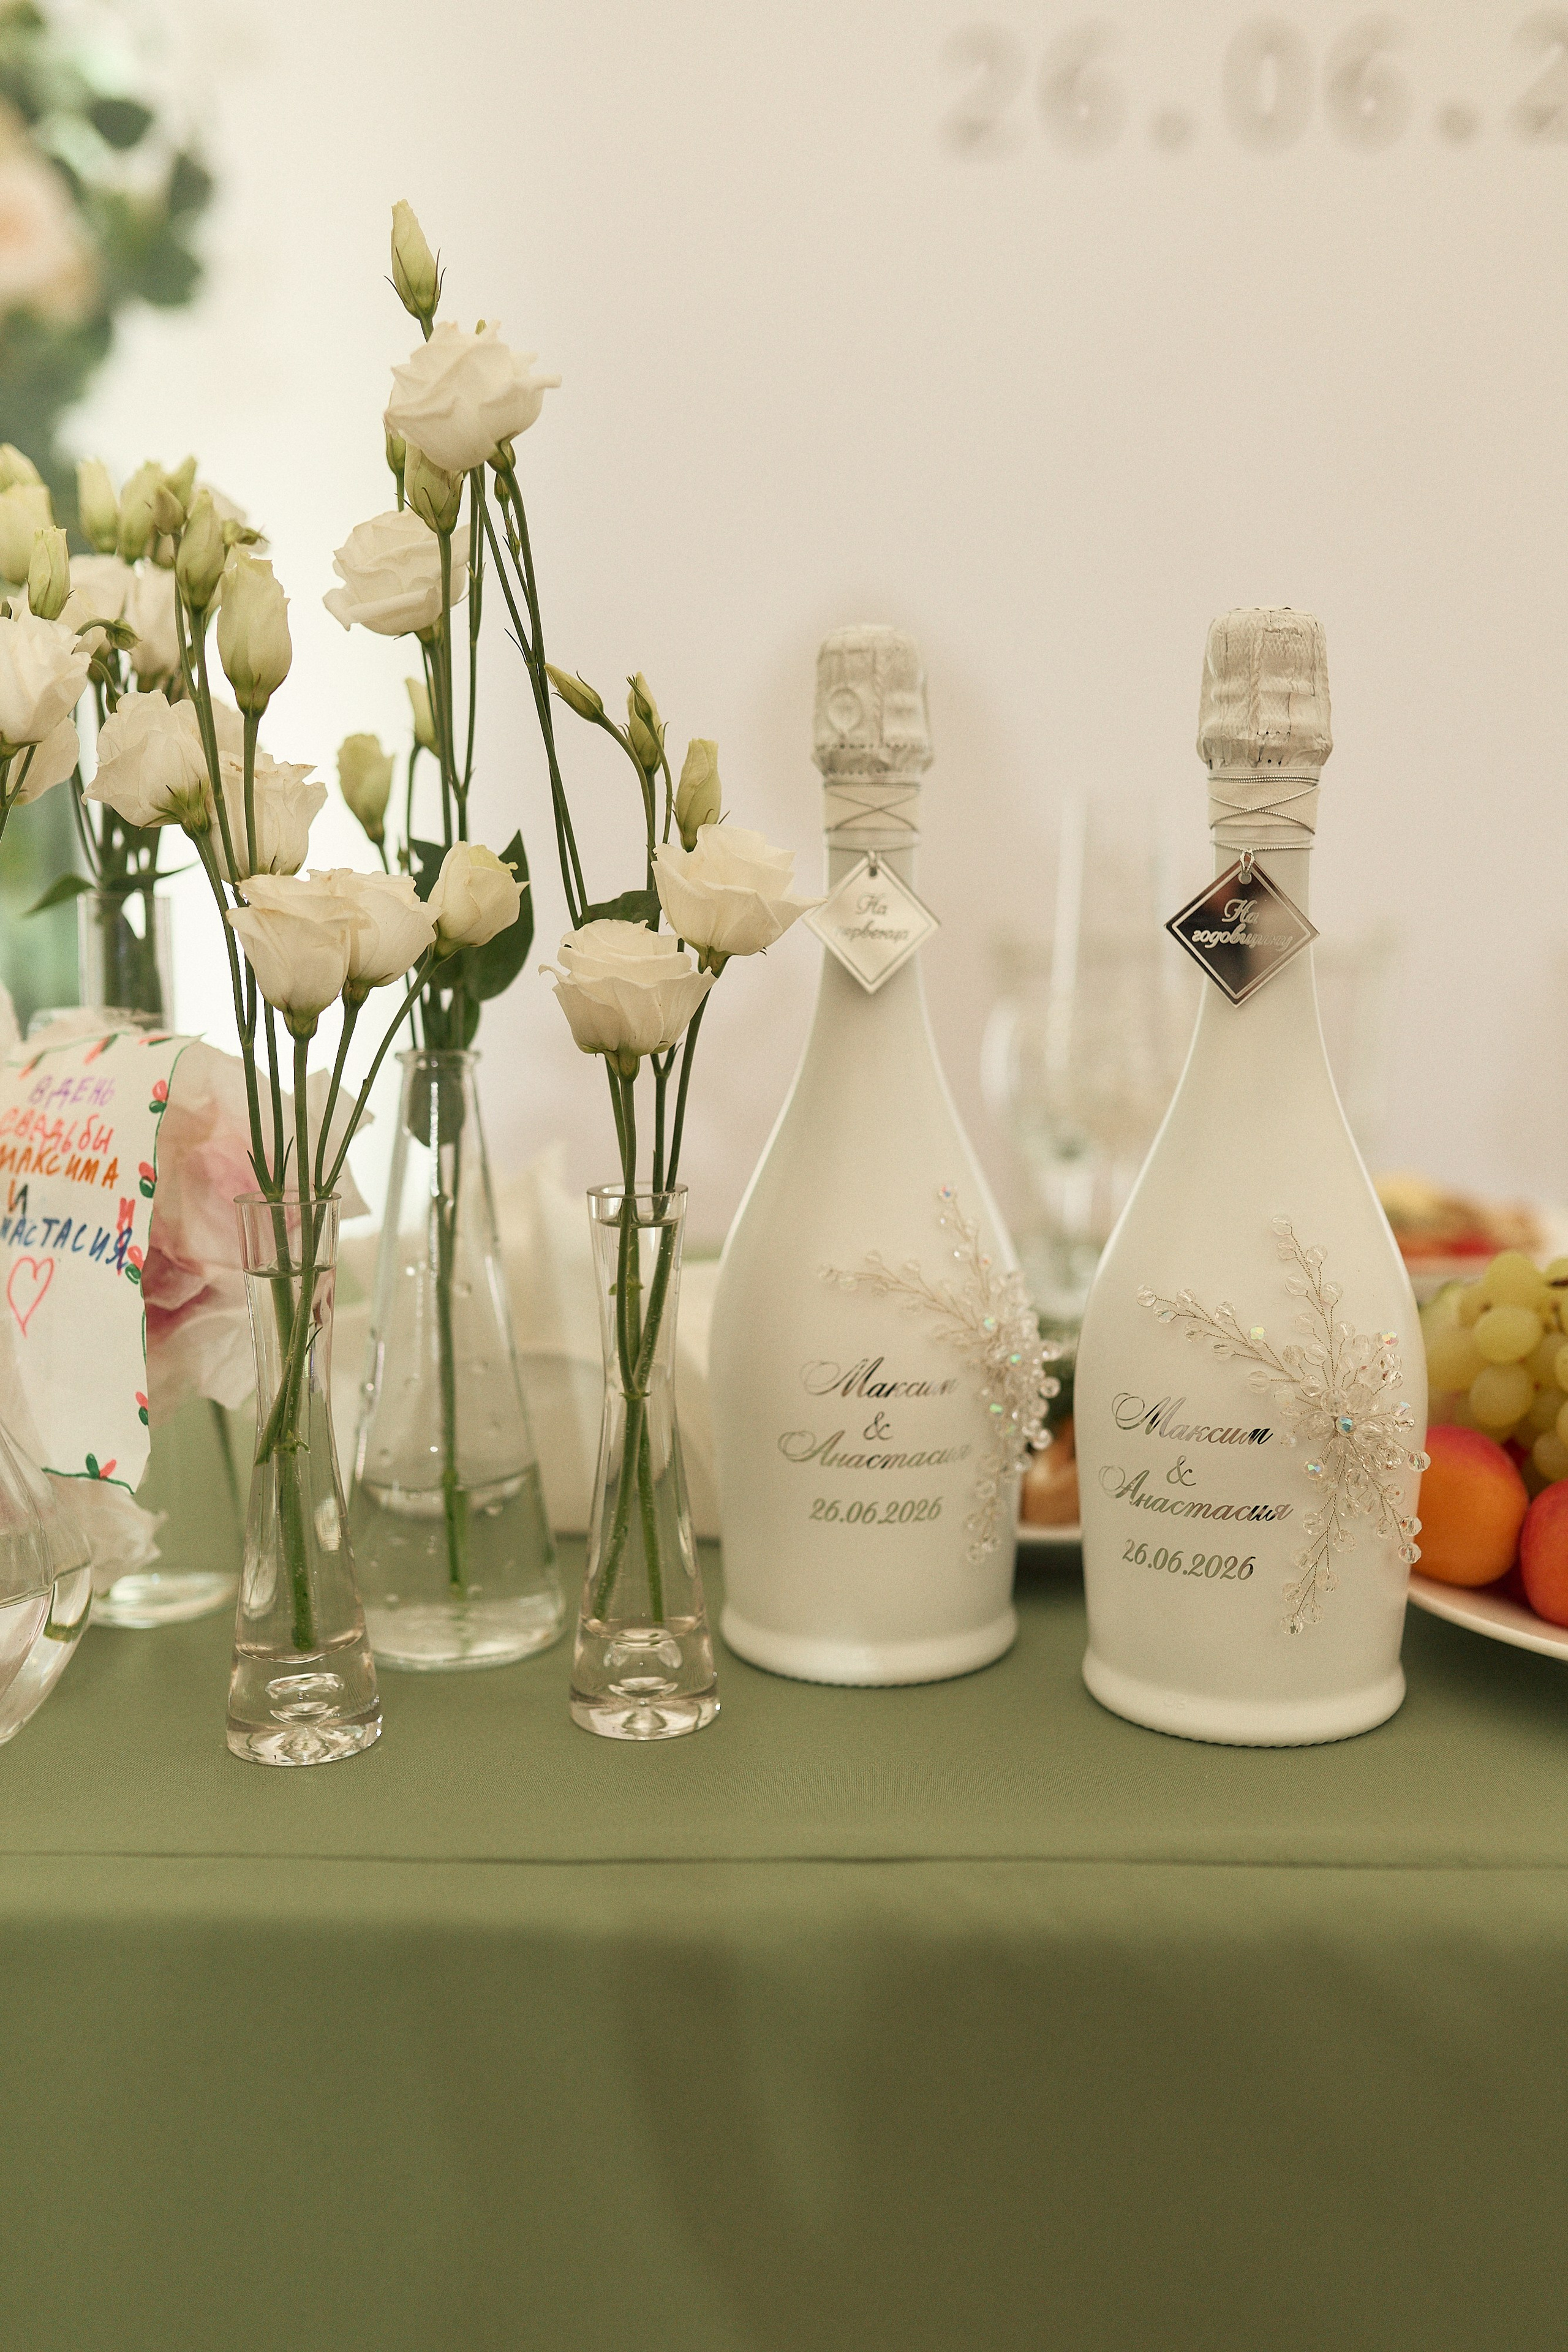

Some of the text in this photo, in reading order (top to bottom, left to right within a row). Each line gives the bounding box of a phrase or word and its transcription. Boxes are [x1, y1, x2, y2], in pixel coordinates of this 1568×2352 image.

[1221, 898, 1259, 924] На
[7, 1178, 28, 1215] И
[799, 1356, 959, 1398] Максим
[863, 1411, 894, 1441] &
[1112, 1392, 1273, 1445] Максим
[777, 1430, 972, 1469] Анастасия
[1166, 1455, 1196, 1487] &
[809, 1496, 944, 1525] 26.06.2026
[1098, 1465, 1294, 1521] Анастасия
[1122, 1538, 1256, 1581] 26.06.2026
